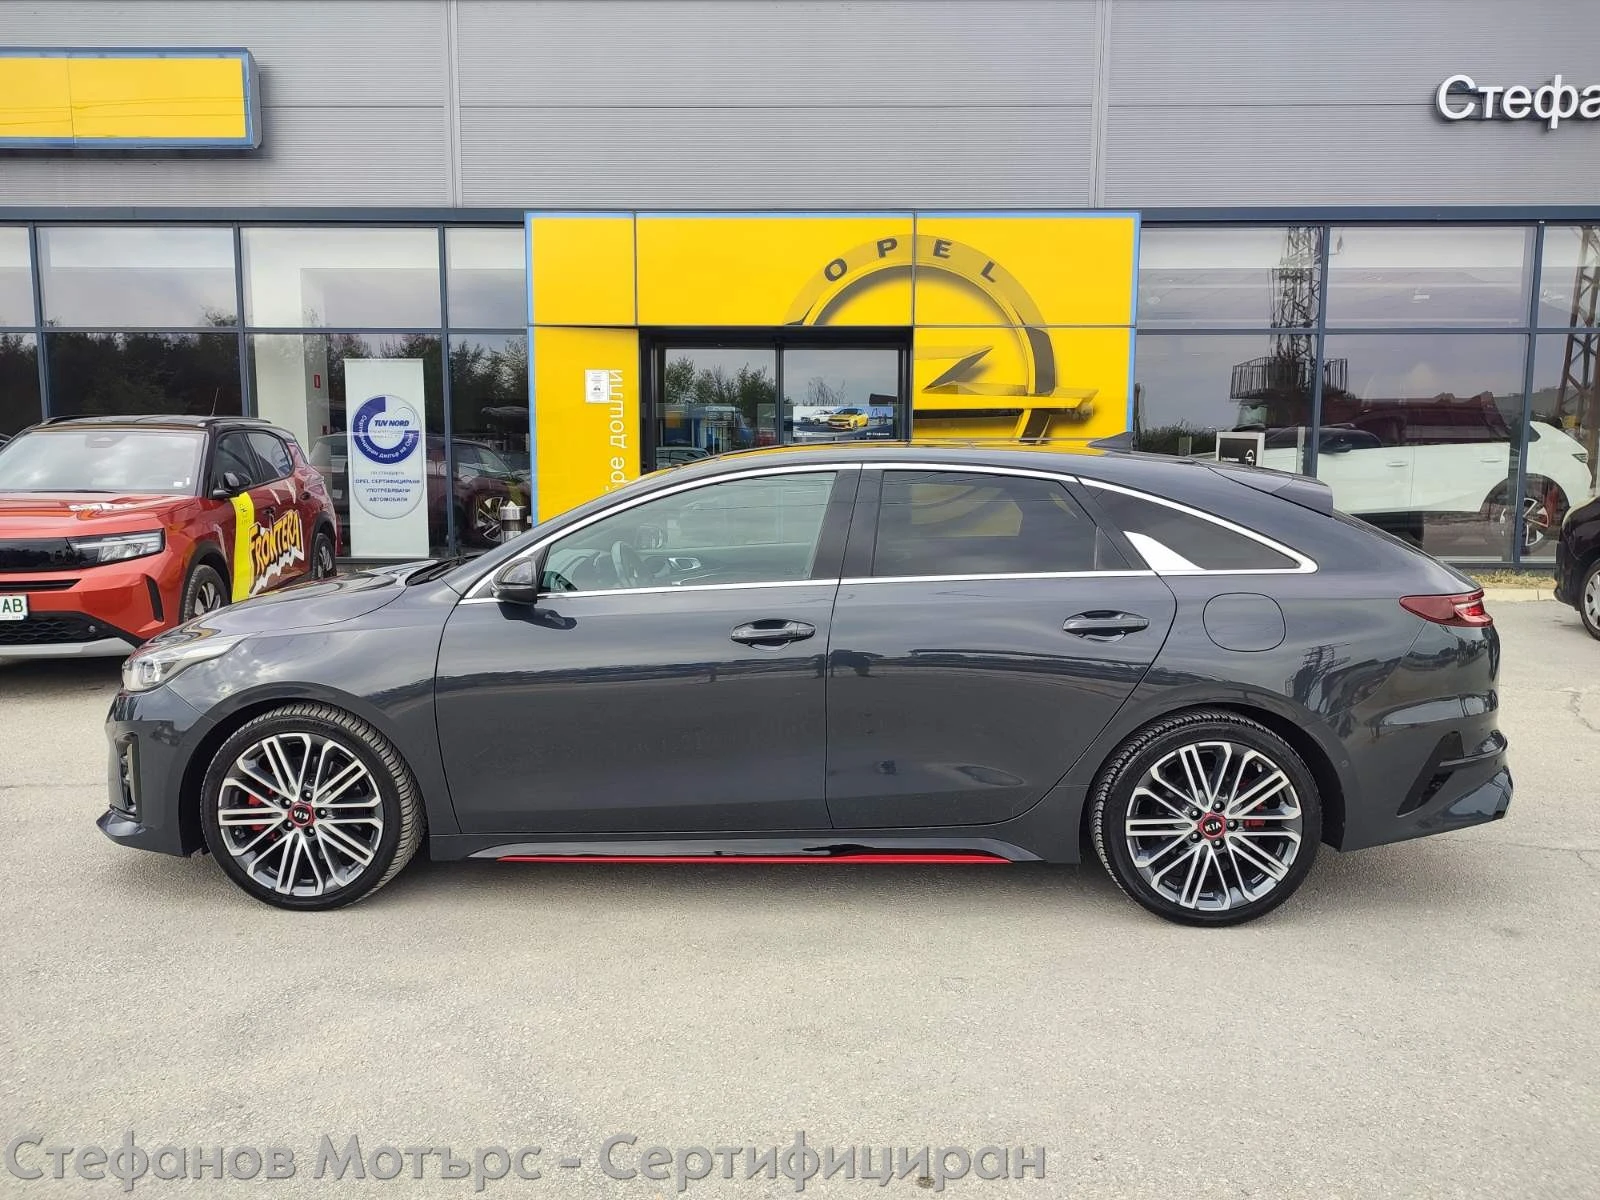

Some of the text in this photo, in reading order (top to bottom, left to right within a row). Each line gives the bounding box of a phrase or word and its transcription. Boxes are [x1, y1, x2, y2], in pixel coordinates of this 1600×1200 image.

[1436, 74, 1600, 129] Стефа
[824, 238, 997, 283] OPEL
[609, 369, 628, 448] дошли
[248, 509, 302, 592] FRONTERA
[1205, 822, 1221, 832] KIA
